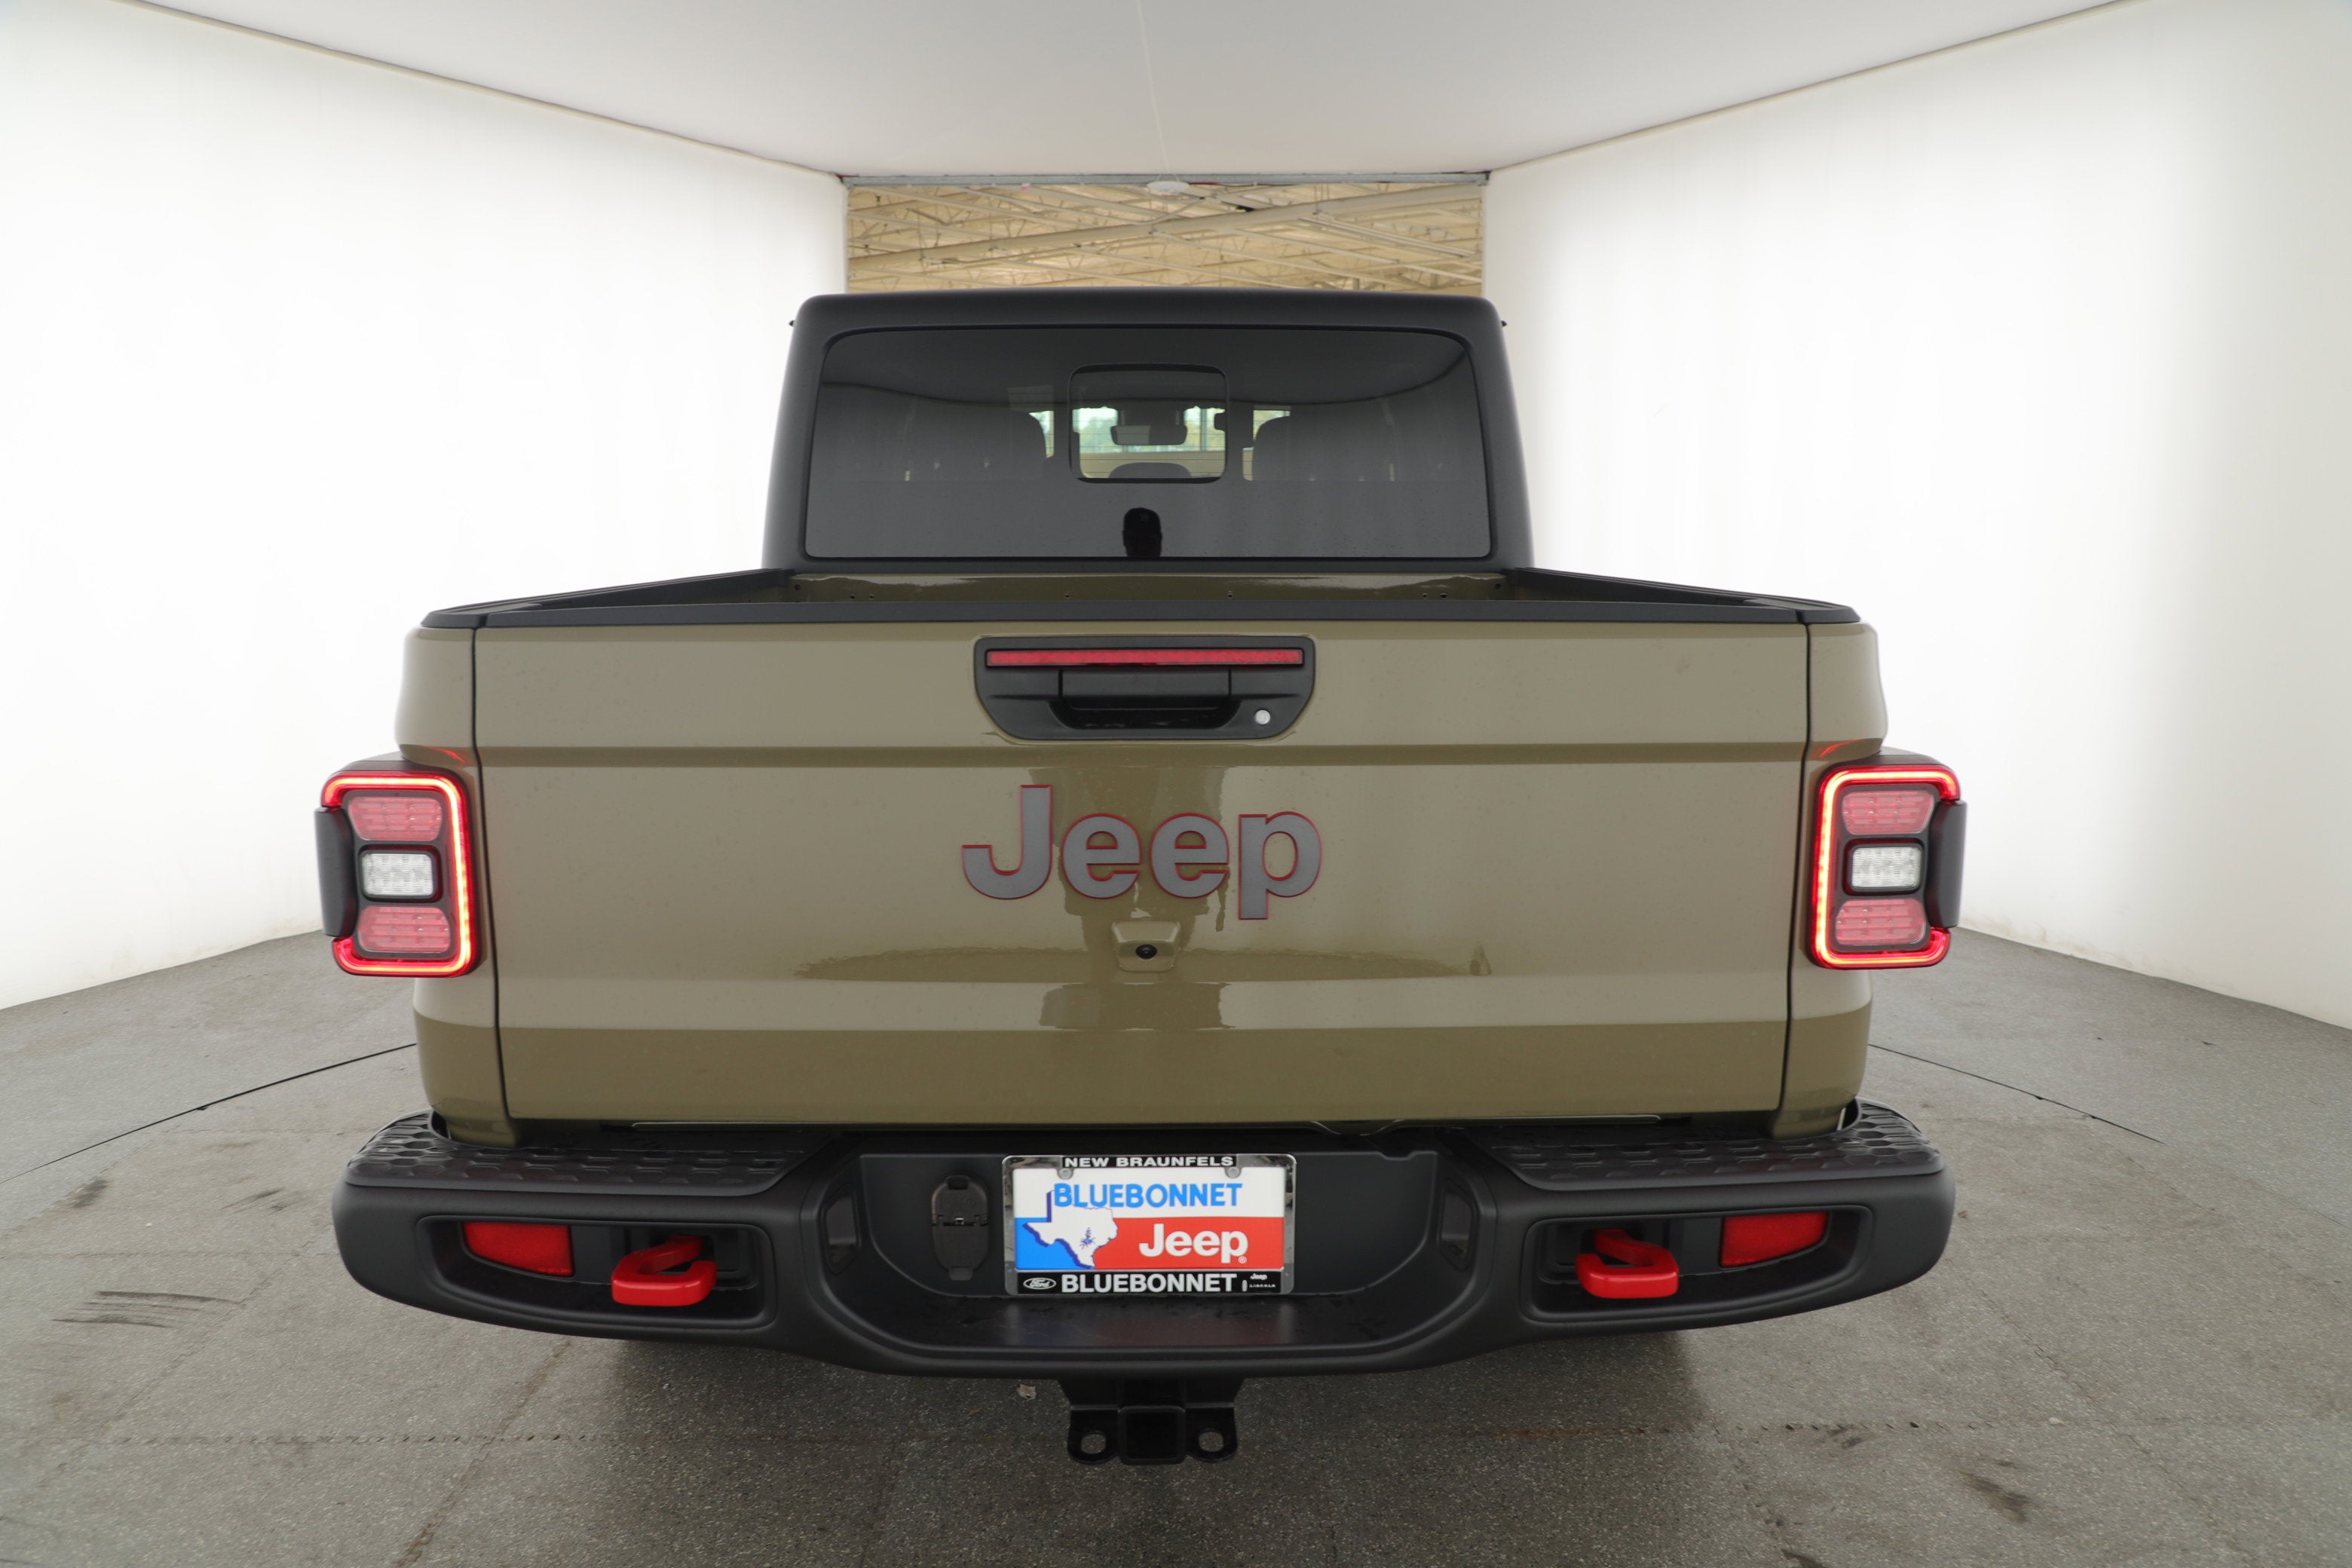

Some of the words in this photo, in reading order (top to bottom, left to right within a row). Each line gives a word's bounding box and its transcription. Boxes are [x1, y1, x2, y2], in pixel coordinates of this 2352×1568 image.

[962, 784, 1321, 920] Jeep
[1064, 1157, 1110, 1168] NEW
[1116, 1156, 1234, 1168] BRAUNFELS
[1054, 1182, 1243, 1208] BLUEBONNET
[1138, 1223, 1249, 1263] Jeep
[1061, 1272, 1237, 1294] BLUEBONNET
